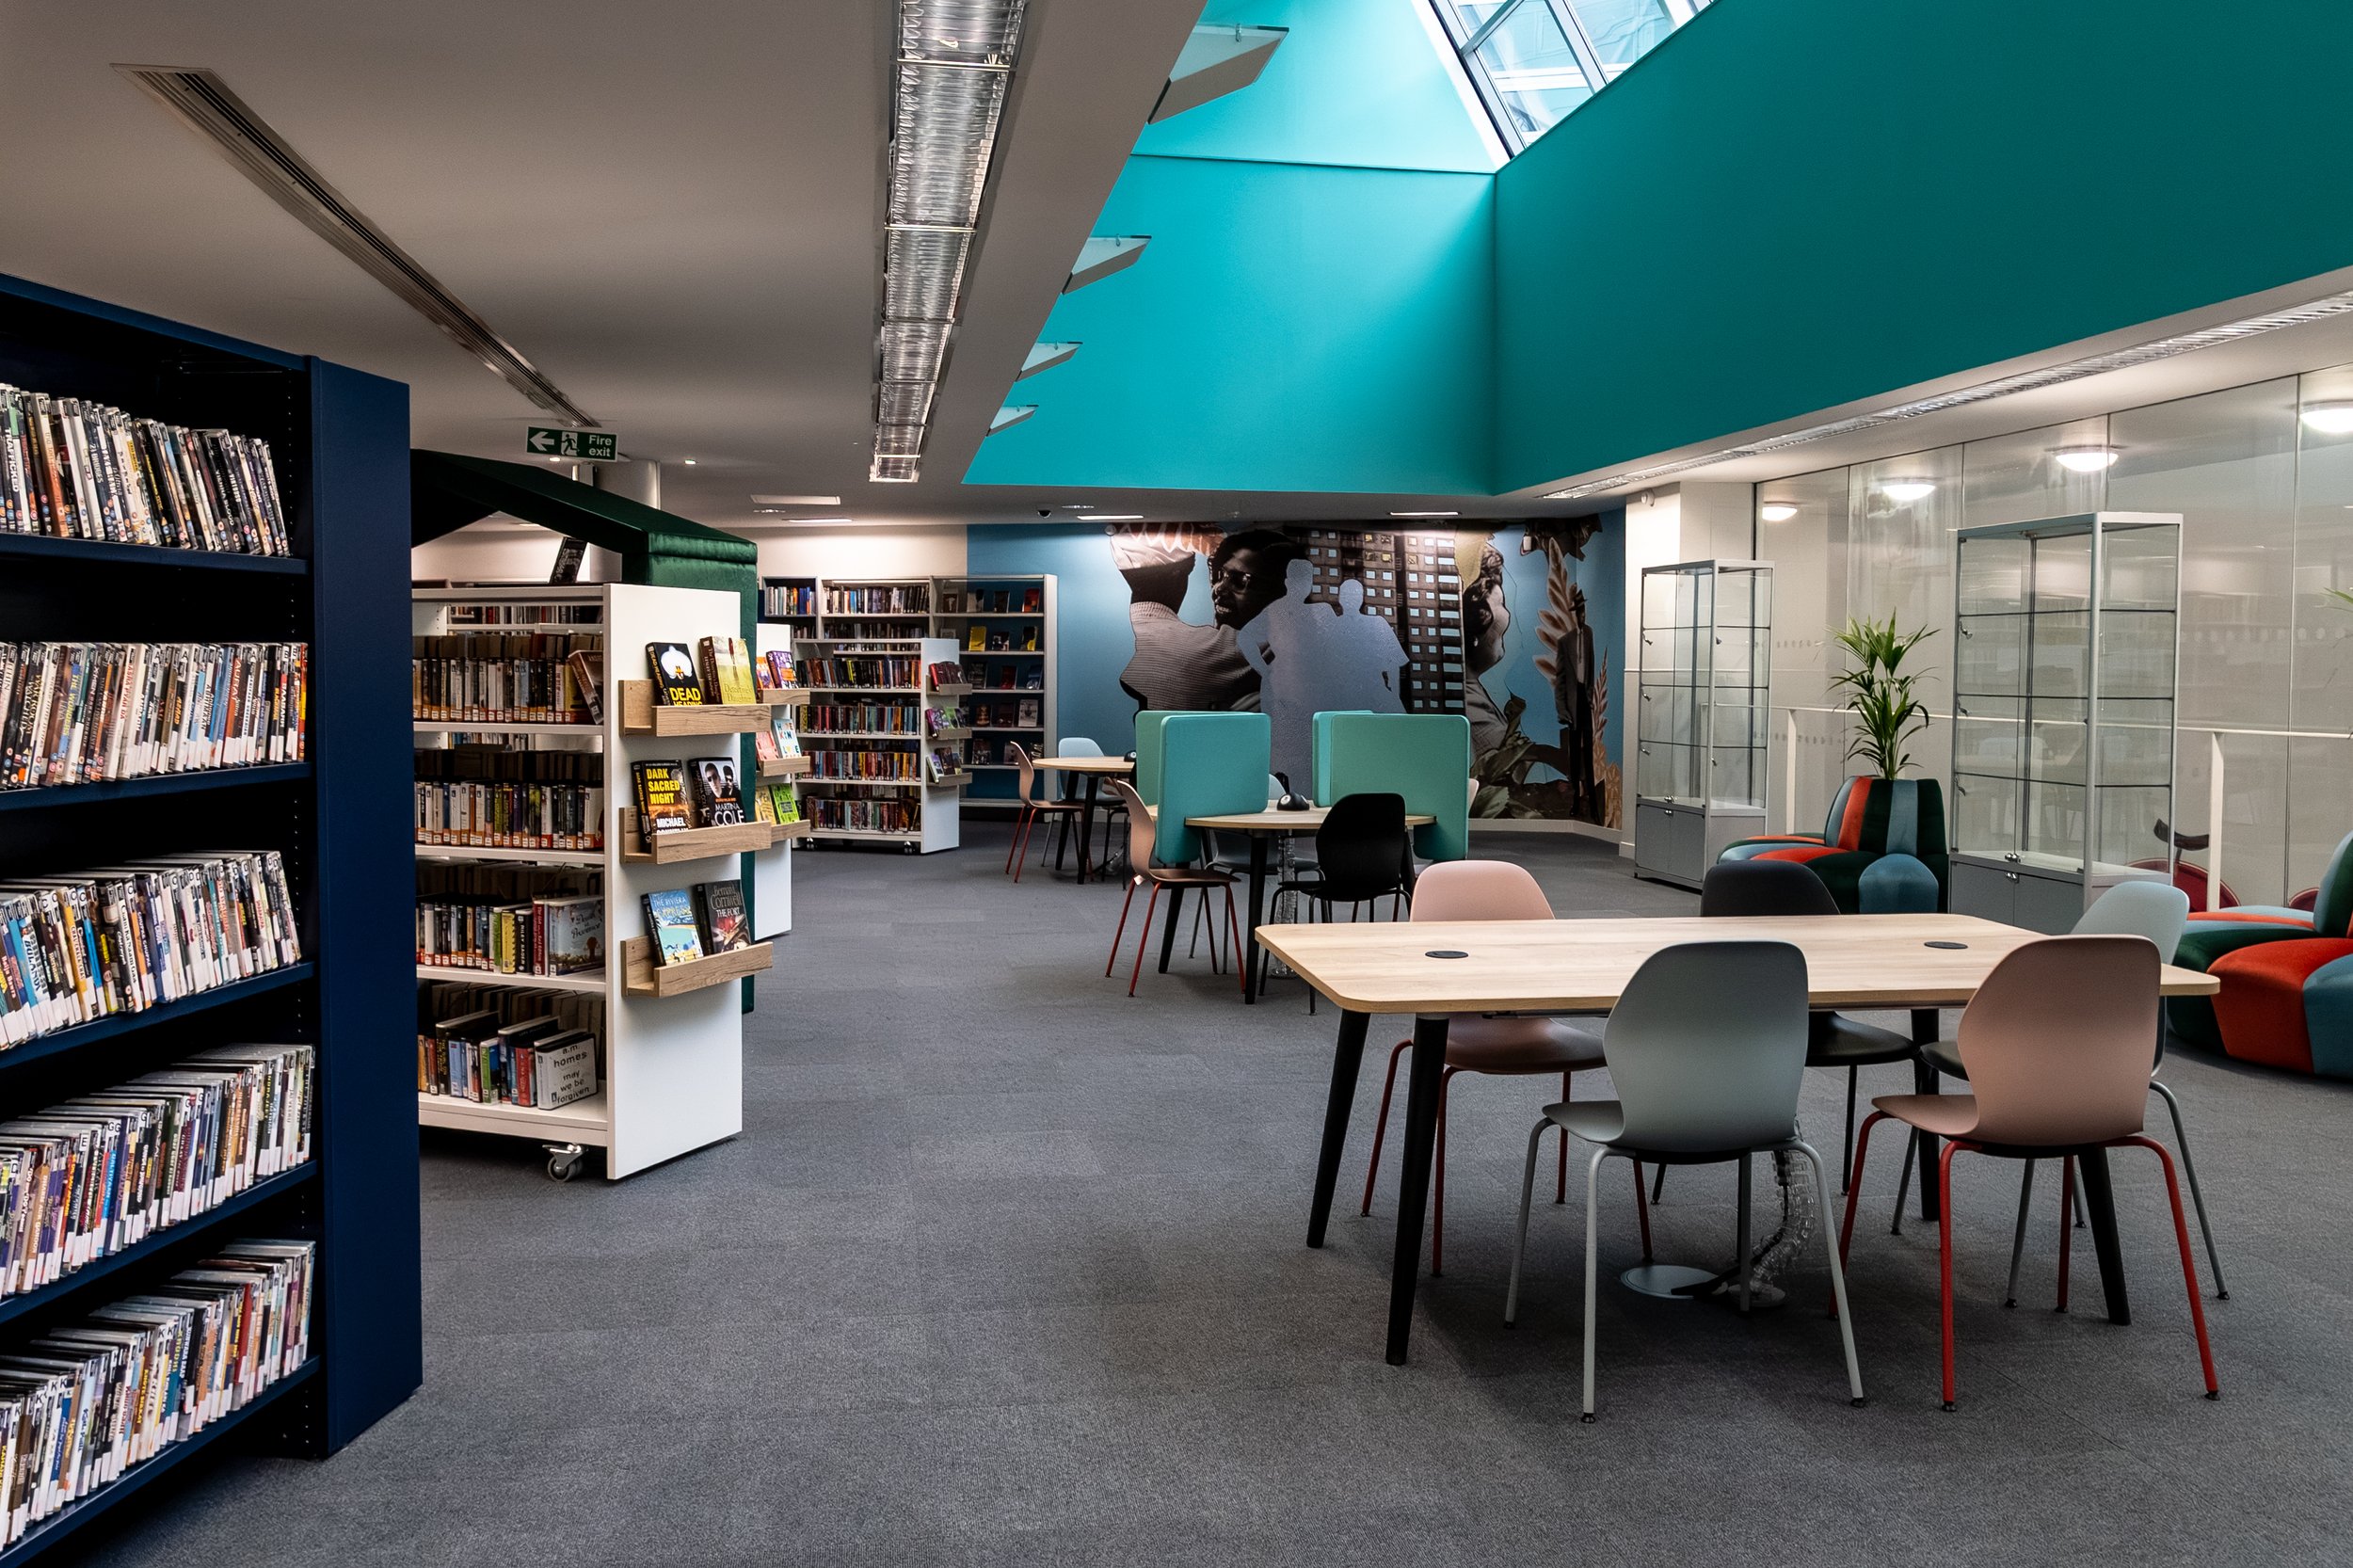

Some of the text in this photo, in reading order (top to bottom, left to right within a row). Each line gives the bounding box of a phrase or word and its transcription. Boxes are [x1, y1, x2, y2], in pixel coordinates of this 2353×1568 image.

[588, 435, 613, 446] Fire
[588, 447, 612, 457] exit
[5, 427, 20, 492] TRAFFICKED
[89, 443, 104, 484] 21 BRIDGES
[216, 470, 234, 526] VIENNA BLOOD
[649, 651, 659, 666] DEAD
[90, 666, 100, 695] X-MEN
[669, 687, 701, 701] DEAD
[26, 675, 42, 735] WAR ROOM
[63, 674, 81, 735] THE WONDERS
[646, 768, 670, 780] DARK
[648, 779, 680, 792] SACRED
[649, 792, 675, 805] NIGHT
[715, 802, 741, 811] MARTINA
[656, 816, 687, 828] MICHAEL
[714, 809, 745, 826] COLE
[713, 884, 736, 897] Bernard
[653, 896, 687, 907] THE RIVIERA
[711, 892, 744, 910] Cornwell
[716, 907, 741, 918] THE FORT
[24, 940, 40, 992] BULANDI
[563, 1044, 581, 1055] a.m.
[553, 1051, 587, 1068] homes
[563, 1070, 580, 1081] may
[560, 1078, 584, 1093] we be
[557, 1086, 590, 1104] forgiven
[141, 1112, 147, 1121] G
[108, 1122, 114, 1131] G
[115, 1124, 121, 1132] G
[81, 1137, 88, 1146] E
[51, 1382, 57, 1391] K
[60, 1378, 67, 1387] K
[37, 1393, 43, 1403] K
